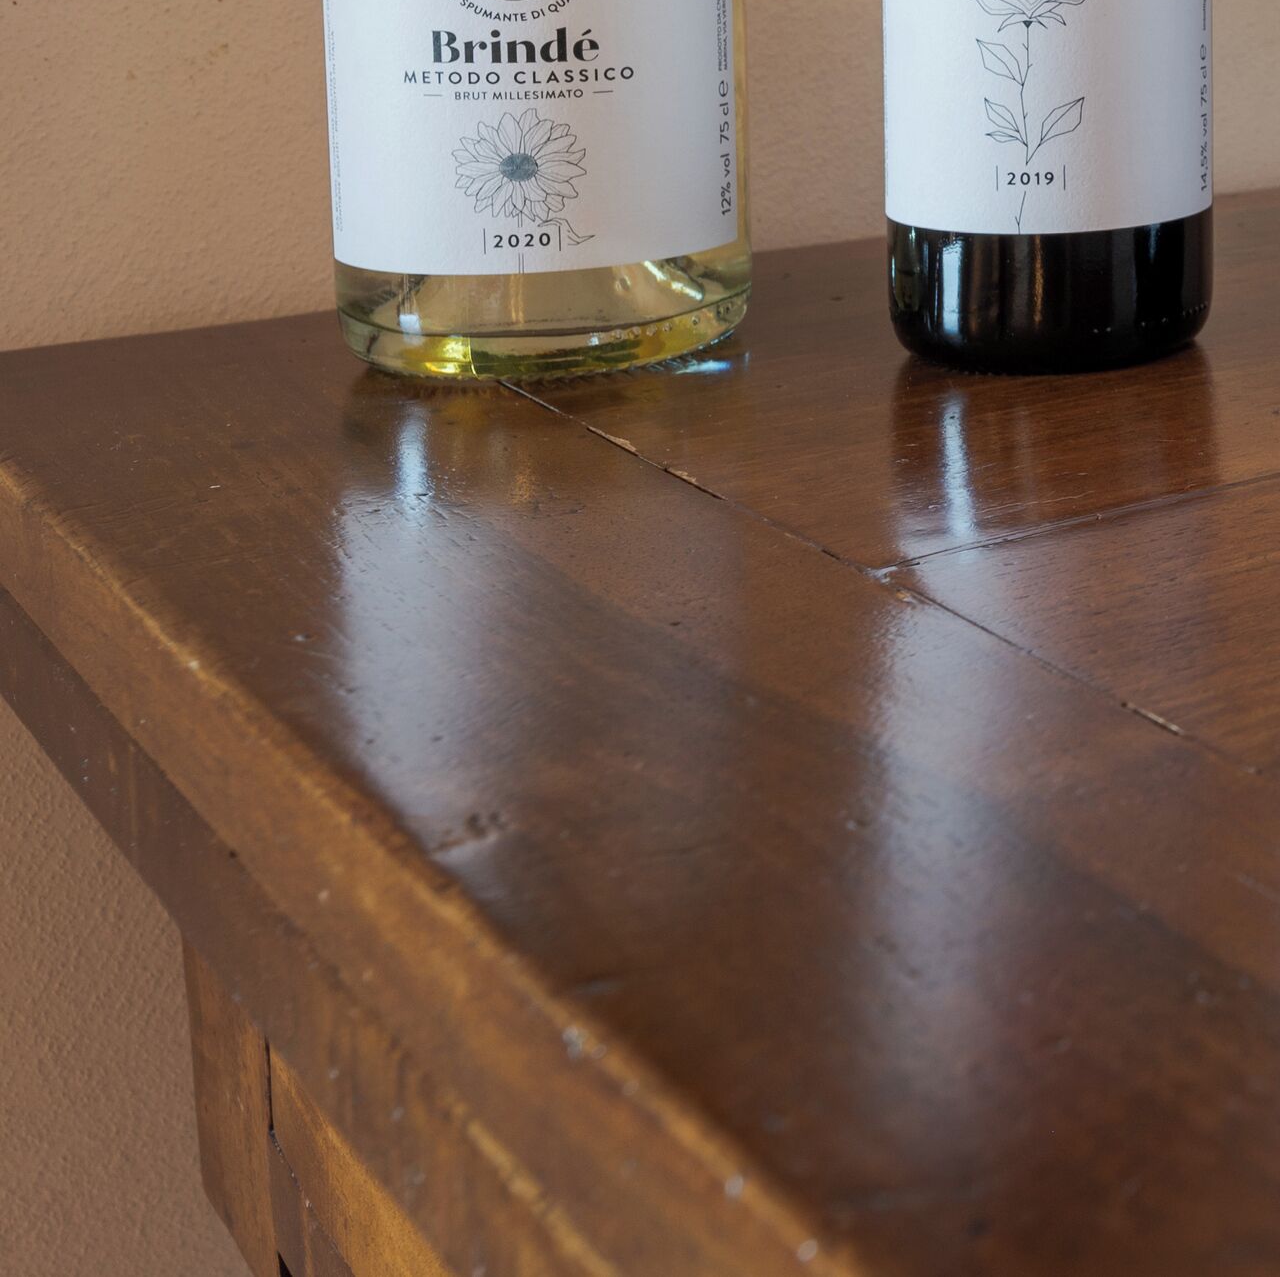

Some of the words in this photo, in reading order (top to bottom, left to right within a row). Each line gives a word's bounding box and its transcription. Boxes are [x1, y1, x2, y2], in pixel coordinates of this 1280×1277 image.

[531, 8, 546, 19] DI
[432, 27, 600, 64] Brindé
[404, 71, 500, 85] METODO
[514, 66, 634, 84] CLASSICO
[454, 91, 488, 100] BRUT
[492, 88, 584, 100] MILLESIMATO
[1200, 84, 1208, 106] 75
[719, 101, 730, 116] cl
[719, 121, 730, 144] 75
[1200, 113, 1208, 137] vol
[720, 153, 731, 178] vol
[1007, 171, 1055, 186] 2019
[720, 182, 732, 215] 12%
[494, 232, 551, 248] 2020
